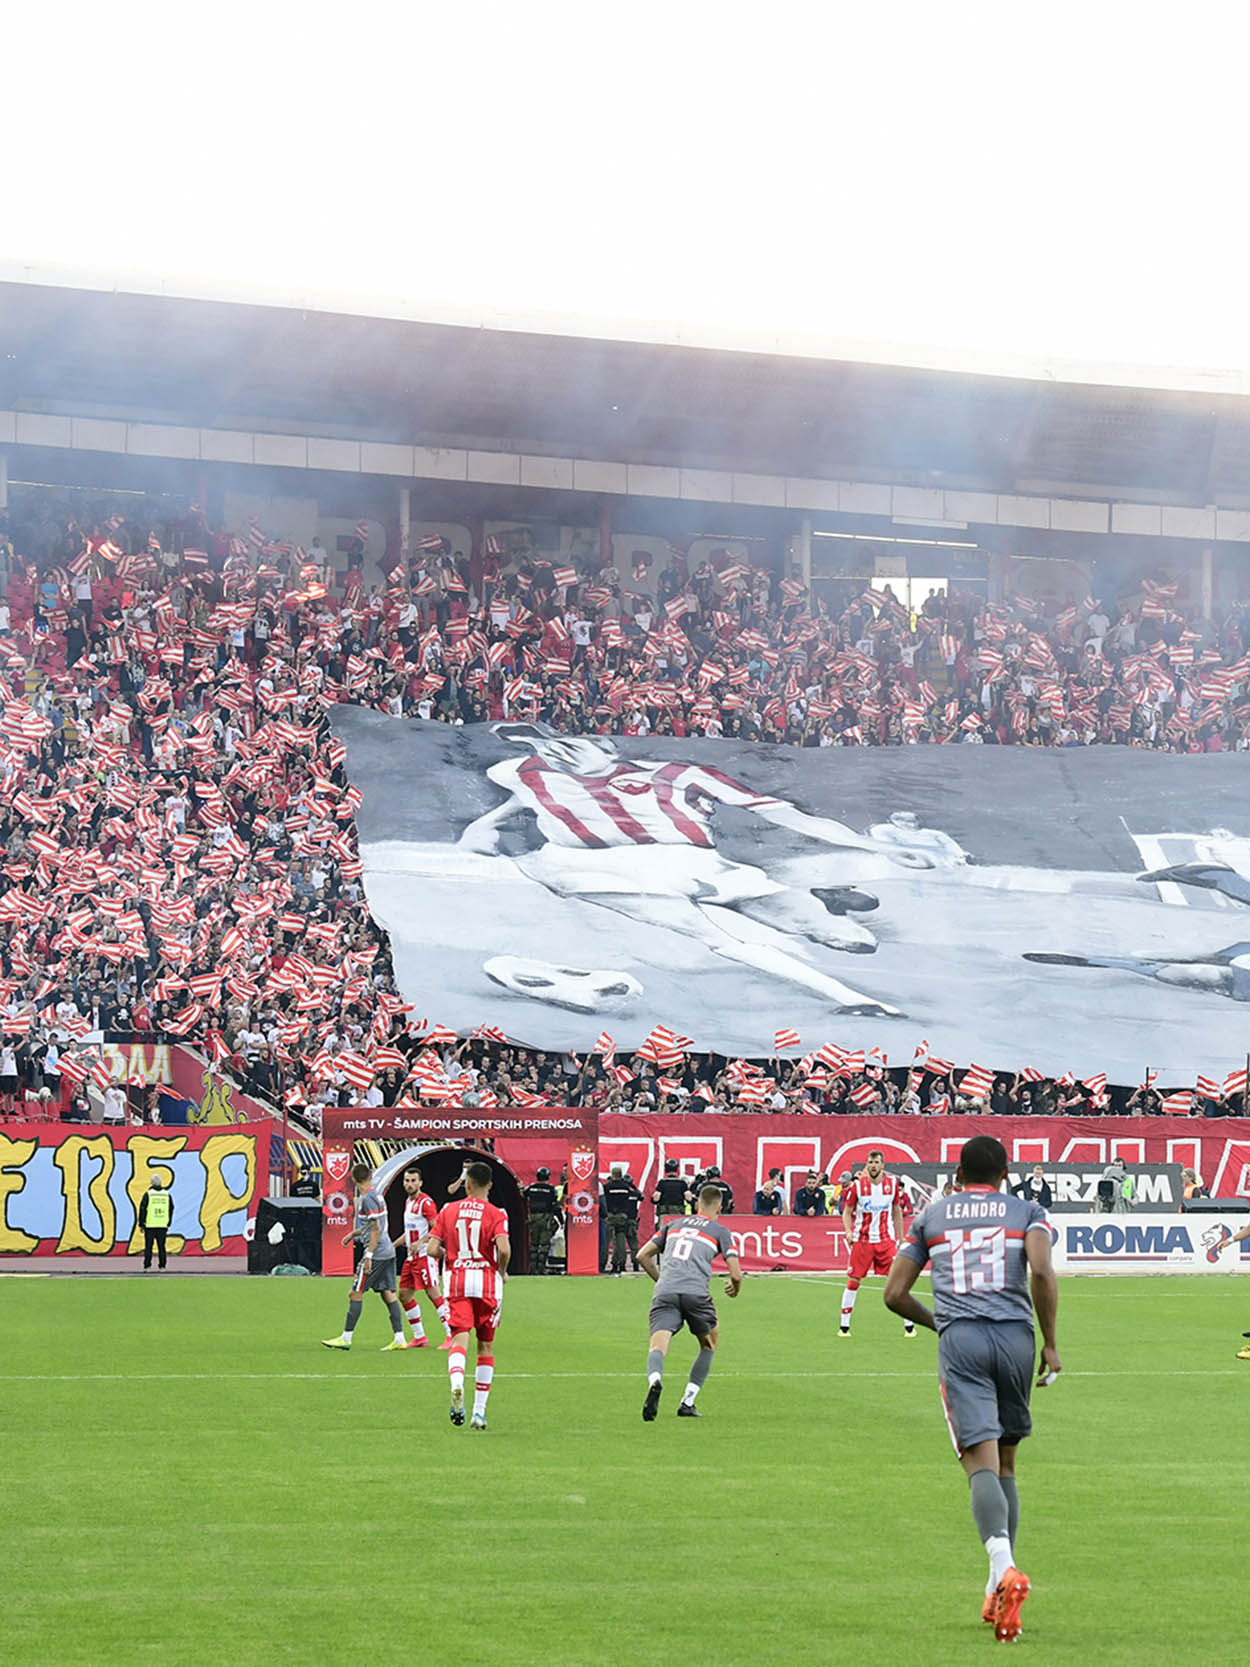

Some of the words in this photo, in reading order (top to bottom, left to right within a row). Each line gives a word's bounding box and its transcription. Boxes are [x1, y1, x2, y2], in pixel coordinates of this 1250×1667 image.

[344, 1121, 366, 1129] mts
[369, 1120, 385, 1129] TV
[394, 1117, 450, 1129] ŠAMPION
[453, 1119, 521, 1130] SPORTSKIH
[524, 1120, 583, 1129] PRENOSA
[327, 1216, 348, 1225] mts
[572, 1215, 593, 1224] mts
[945, 1202, 1007, 1219] LEANDRO
[456, 1219, 484, 1259] 11
[730, 1225, 803, 1258] mts
[1066, 1224, 1194, 1253] ROMA
[944, 1226, 1006, 1295] 13
